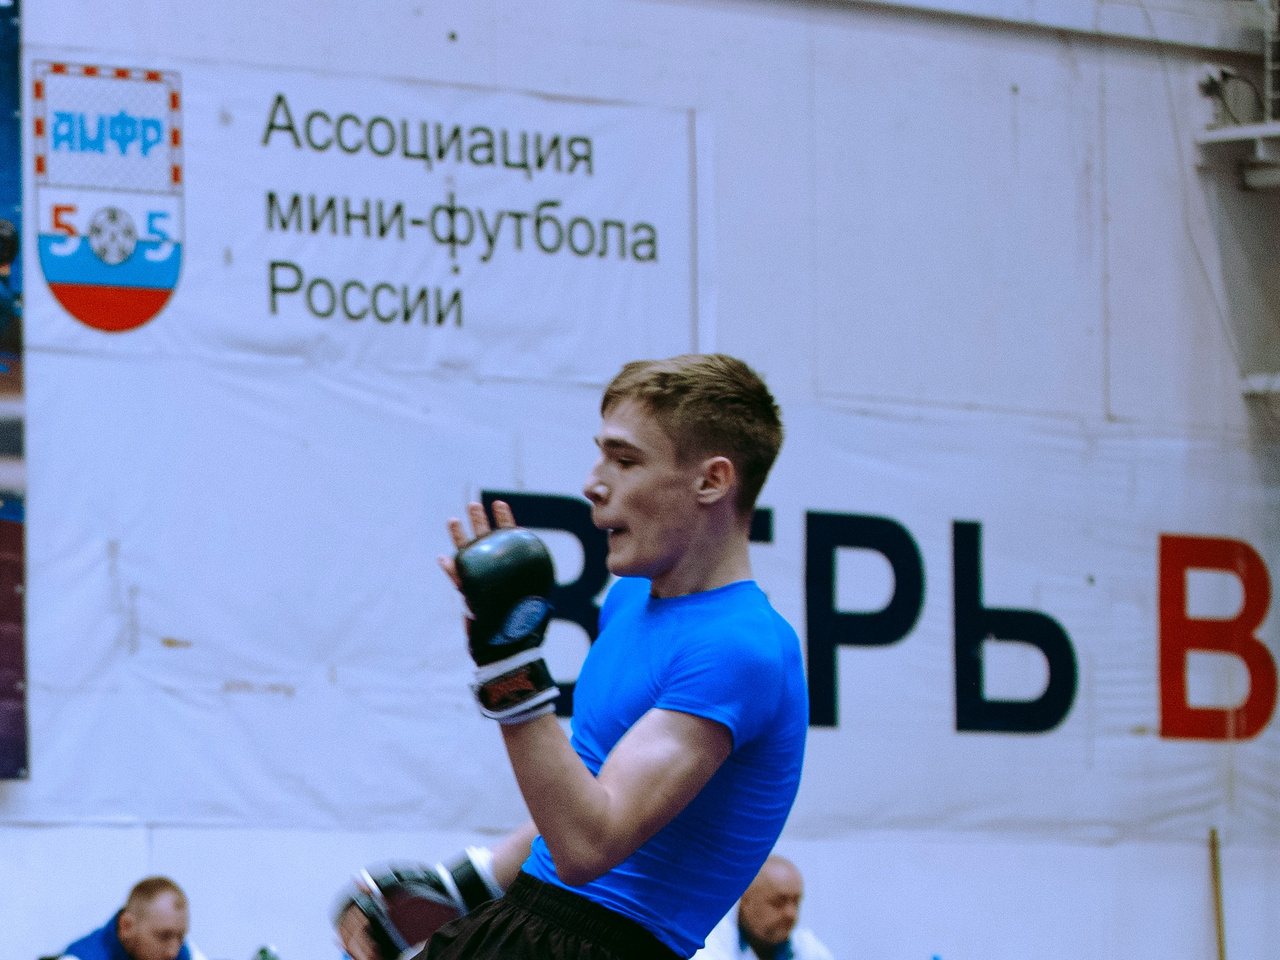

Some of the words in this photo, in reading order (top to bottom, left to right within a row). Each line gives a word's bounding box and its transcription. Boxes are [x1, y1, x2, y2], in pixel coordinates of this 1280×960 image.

[261, 93, 595, 179] Ассоциация
[49, 204, 81, 257] 5
[144, 211, 174, 262] 5
[264, 190, 658, 264] мини-футбола
[267, 259, 464, 328] России
